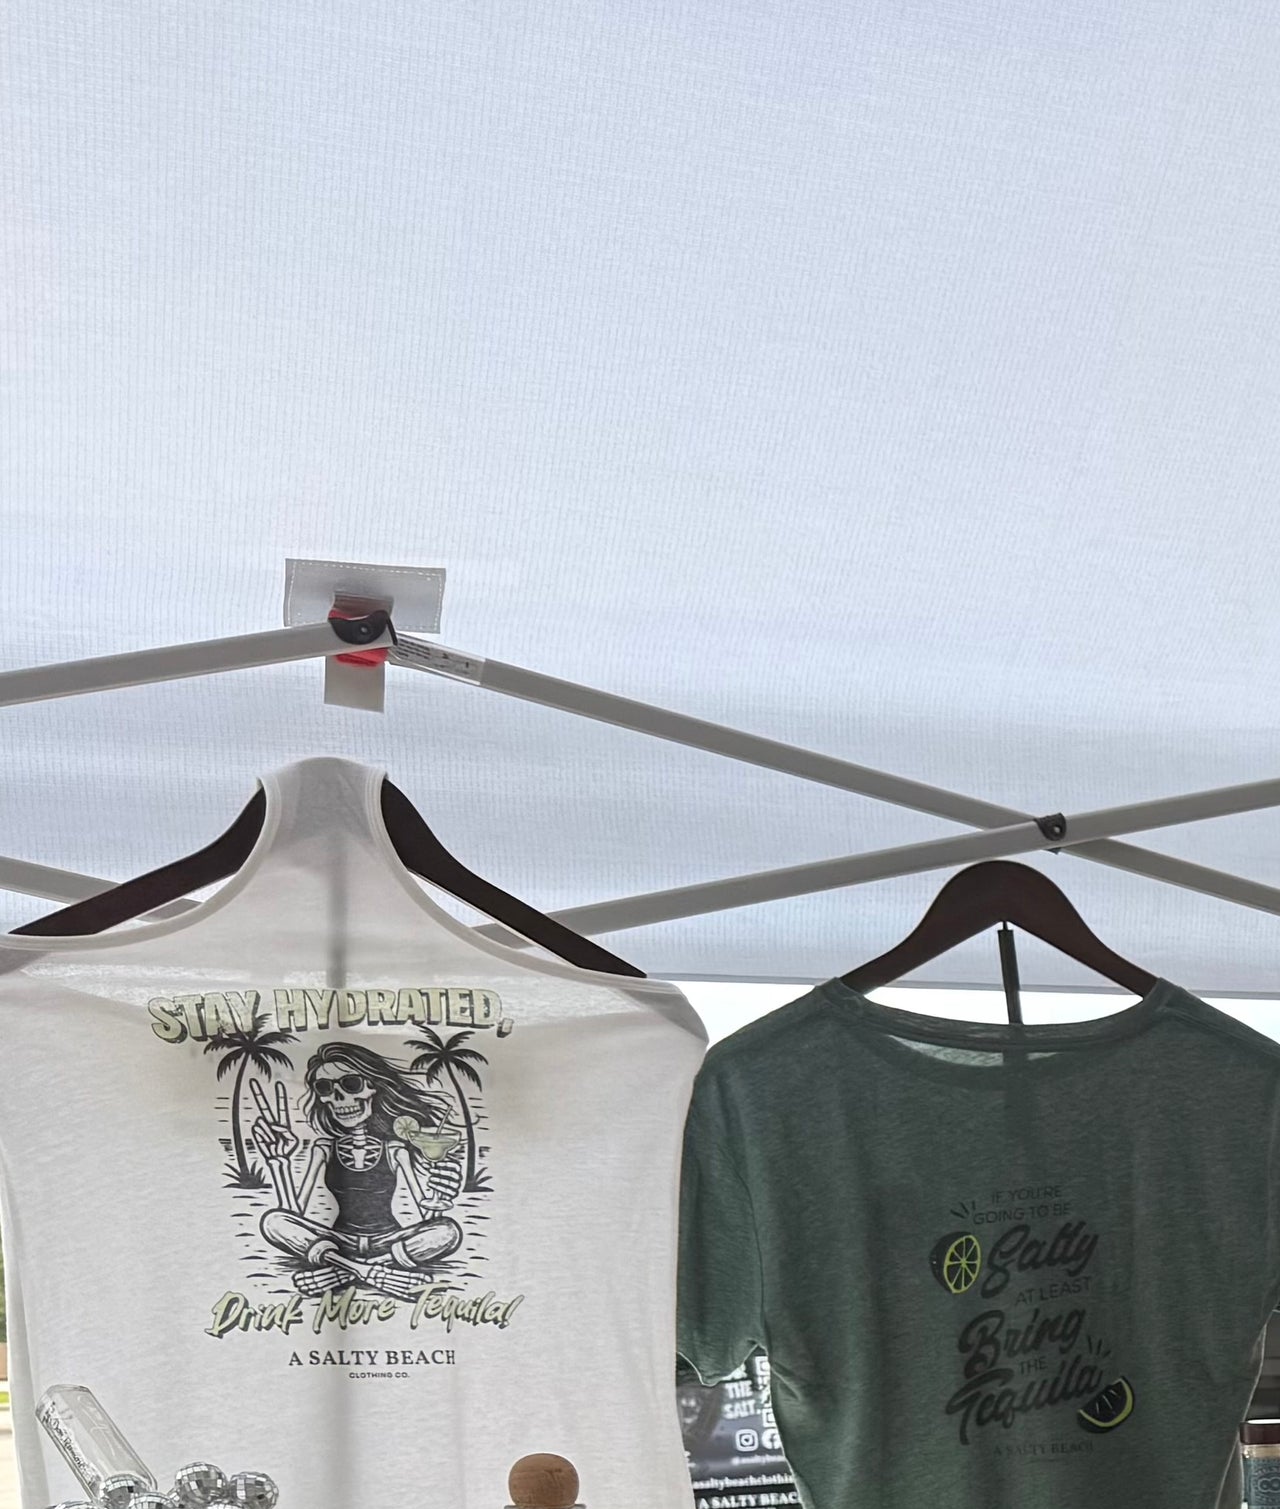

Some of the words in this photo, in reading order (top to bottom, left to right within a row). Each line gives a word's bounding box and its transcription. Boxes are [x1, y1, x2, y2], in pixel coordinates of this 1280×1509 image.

[148, 990, 261, 1043] STAY
[273, 987, 514, 1038] HYDRATED,
[992, 1190, 1002, 1204] IF
[1007, 1185, 1063, 1203] YOU'RE
[973, 1207, 1025, 1226] GOING
[1029, 1205, 1050, 1220] TO
[1053, 1202, 1072, 1217] BE
[980, 1220, 1099, 1299] Salty
[1015, 1289, 1036, 1307] AT
[1039, 1275, 1092, 1300] LEAST
[203, 1290, 304, 1339] Drink
[312, 1286, 399, 1335] More
[407, 1282, 525, 1334] Tequila!
[957, 1307, 1086, 1380] Bring
[287, 1349, 304, 1367] A
[308, 1349, 380, 1367] SALTY
[385, 1349, 456, 1366] BEACH
[1018, 1356, 1049, 1376] THE
[348, 1371, 394, 1379] CLOTHING
[395, 1371, 411, 1379] CO.
[724, 1380, 754, 1400] THE
[945, 1354, 1104, 1446] Tequila
[722, 1399, 762, 1420] SALT.
[698, 1498, 709, 1509] A
[711, 1495, 760, 1509] SALTY
[759, 1491, 801, 1505] BEAC
